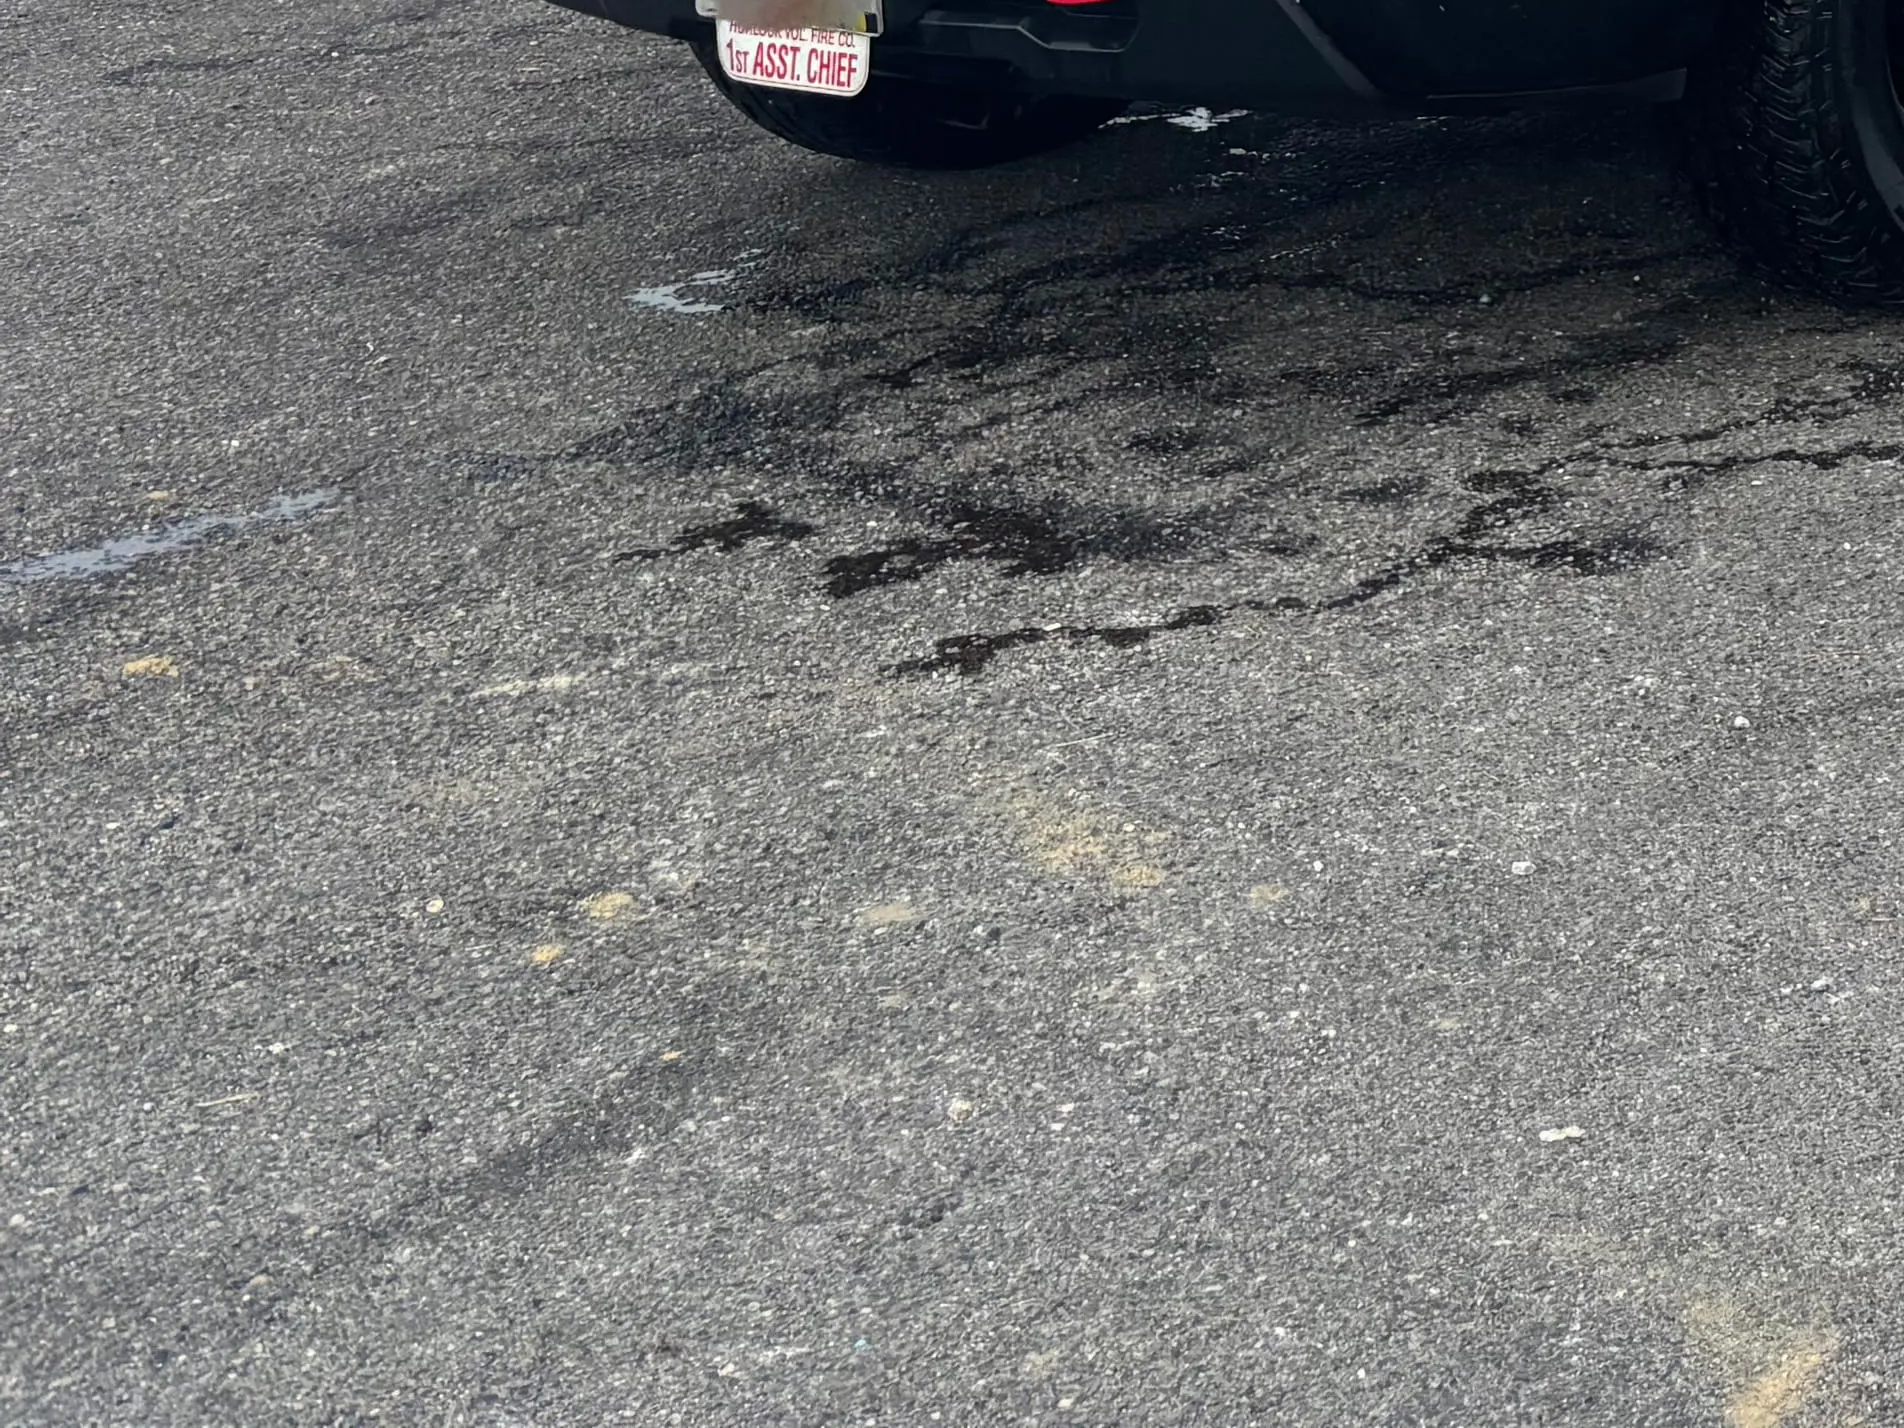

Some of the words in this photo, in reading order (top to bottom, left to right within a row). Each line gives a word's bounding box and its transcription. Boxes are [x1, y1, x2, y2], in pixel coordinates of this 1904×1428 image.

[811, 28, 835, 45] FIRE
[752, 41, 801, 82] ASST.
[806, 47, 858, 89] CHIEF
